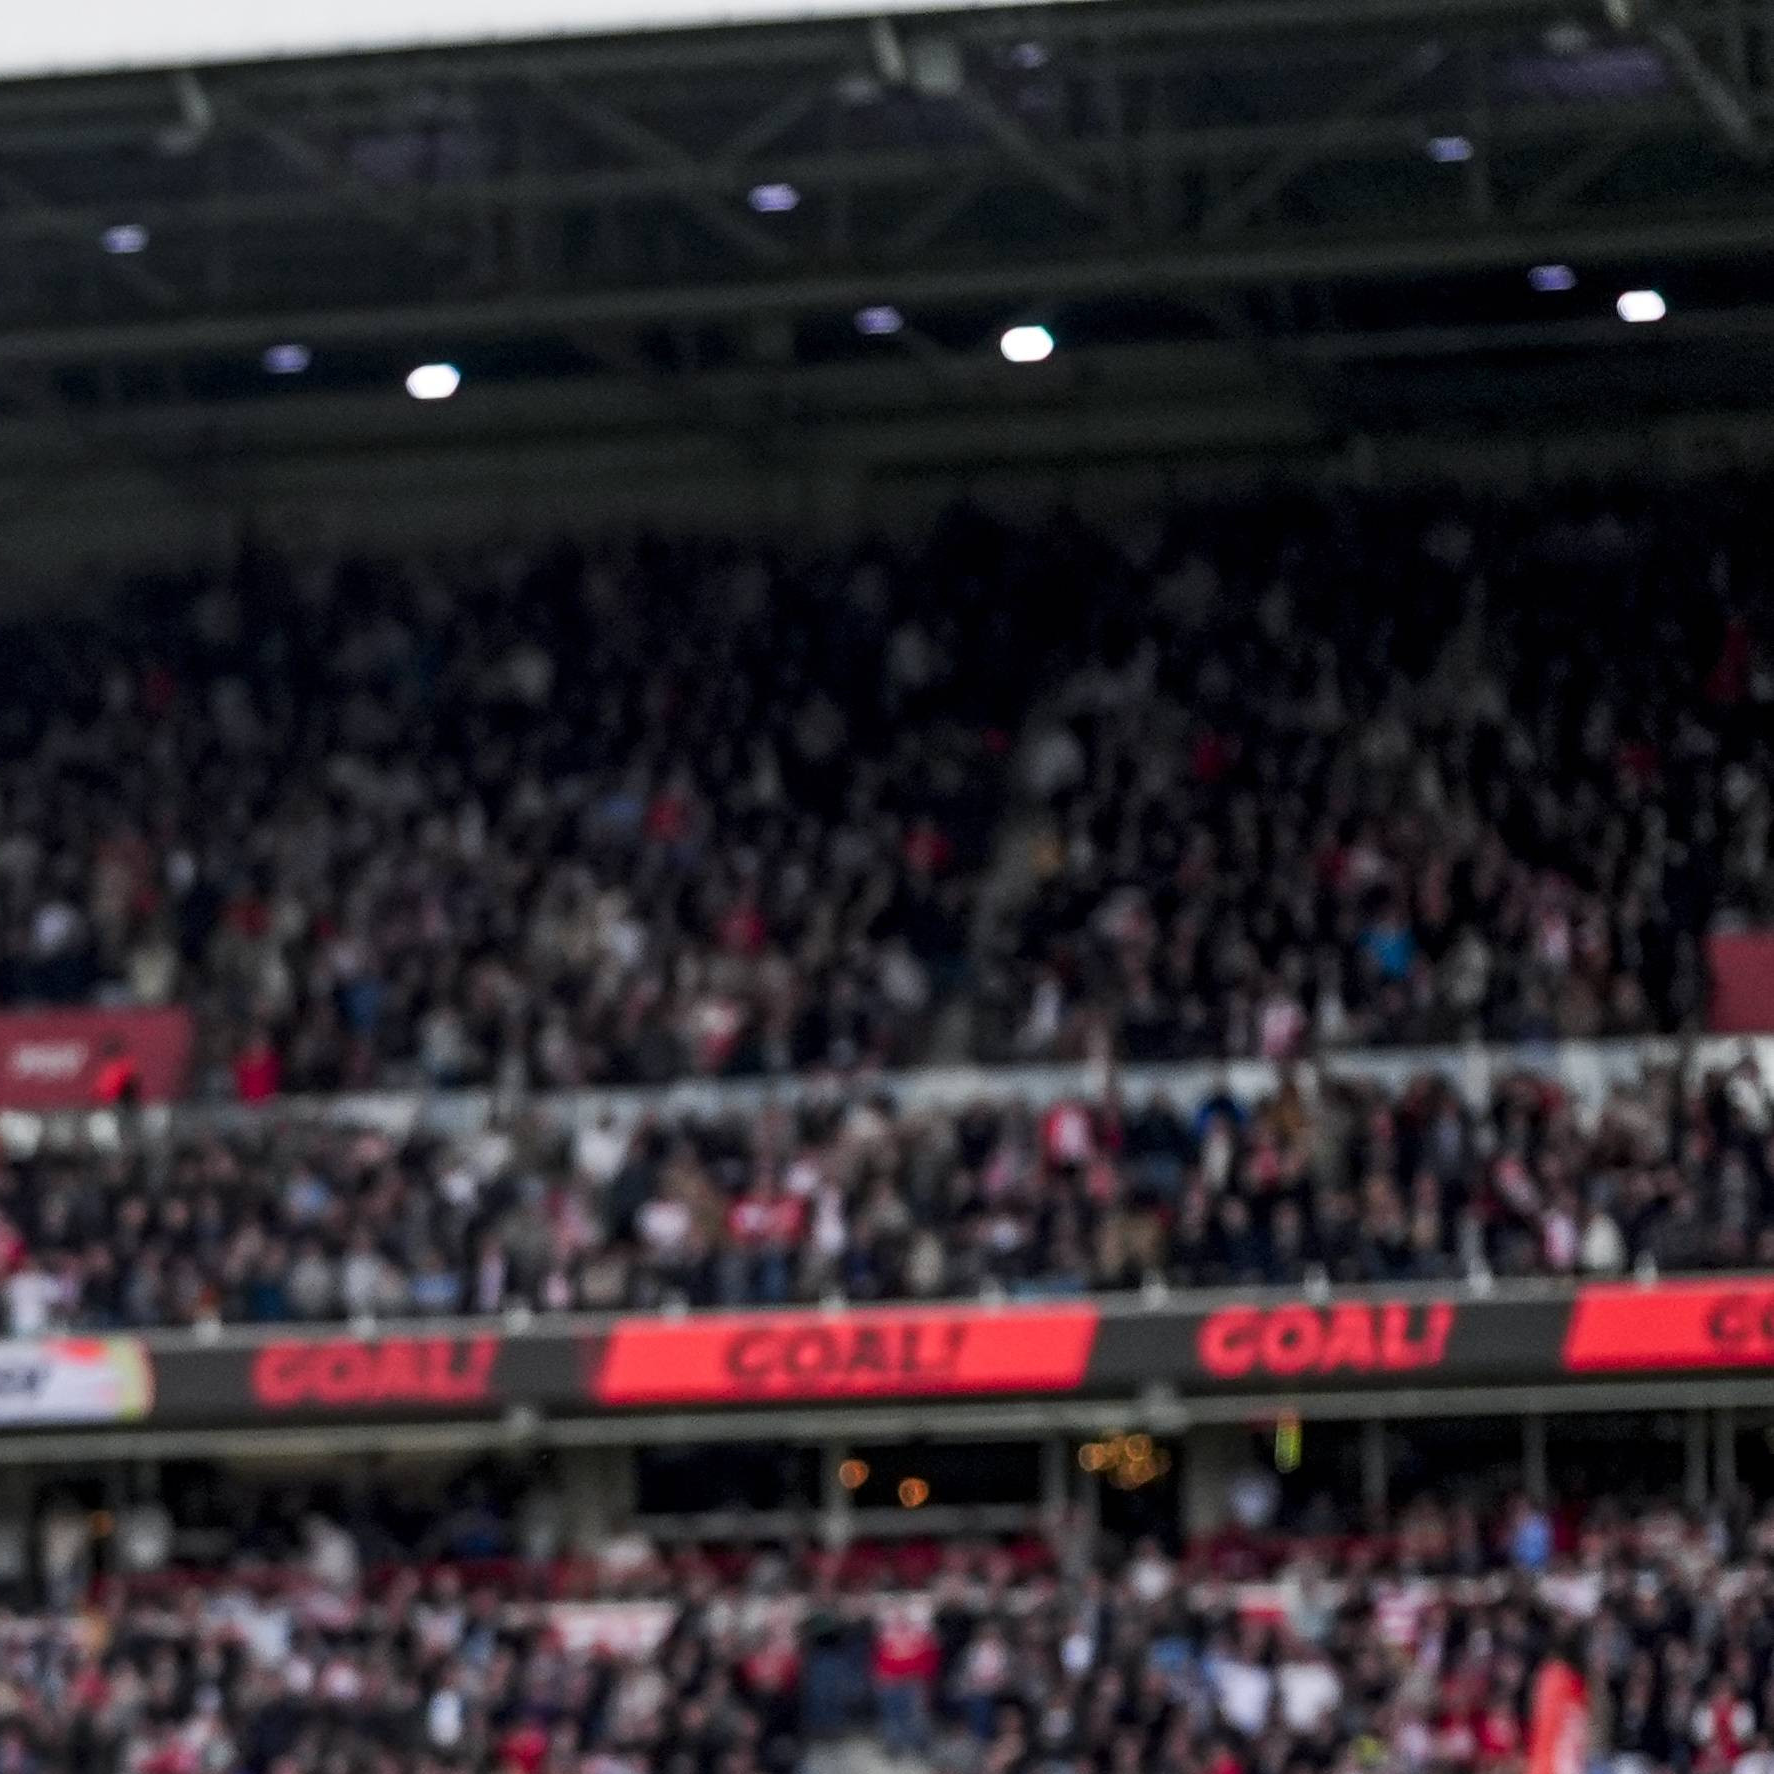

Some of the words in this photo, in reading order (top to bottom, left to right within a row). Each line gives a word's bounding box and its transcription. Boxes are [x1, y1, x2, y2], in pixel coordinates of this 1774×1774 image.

[256, 1338, 499, 1402] GOAL!
[725, 1325, 967, 1381] GOAL!
[1199, 1304, 1453, 1376] GOAL!
